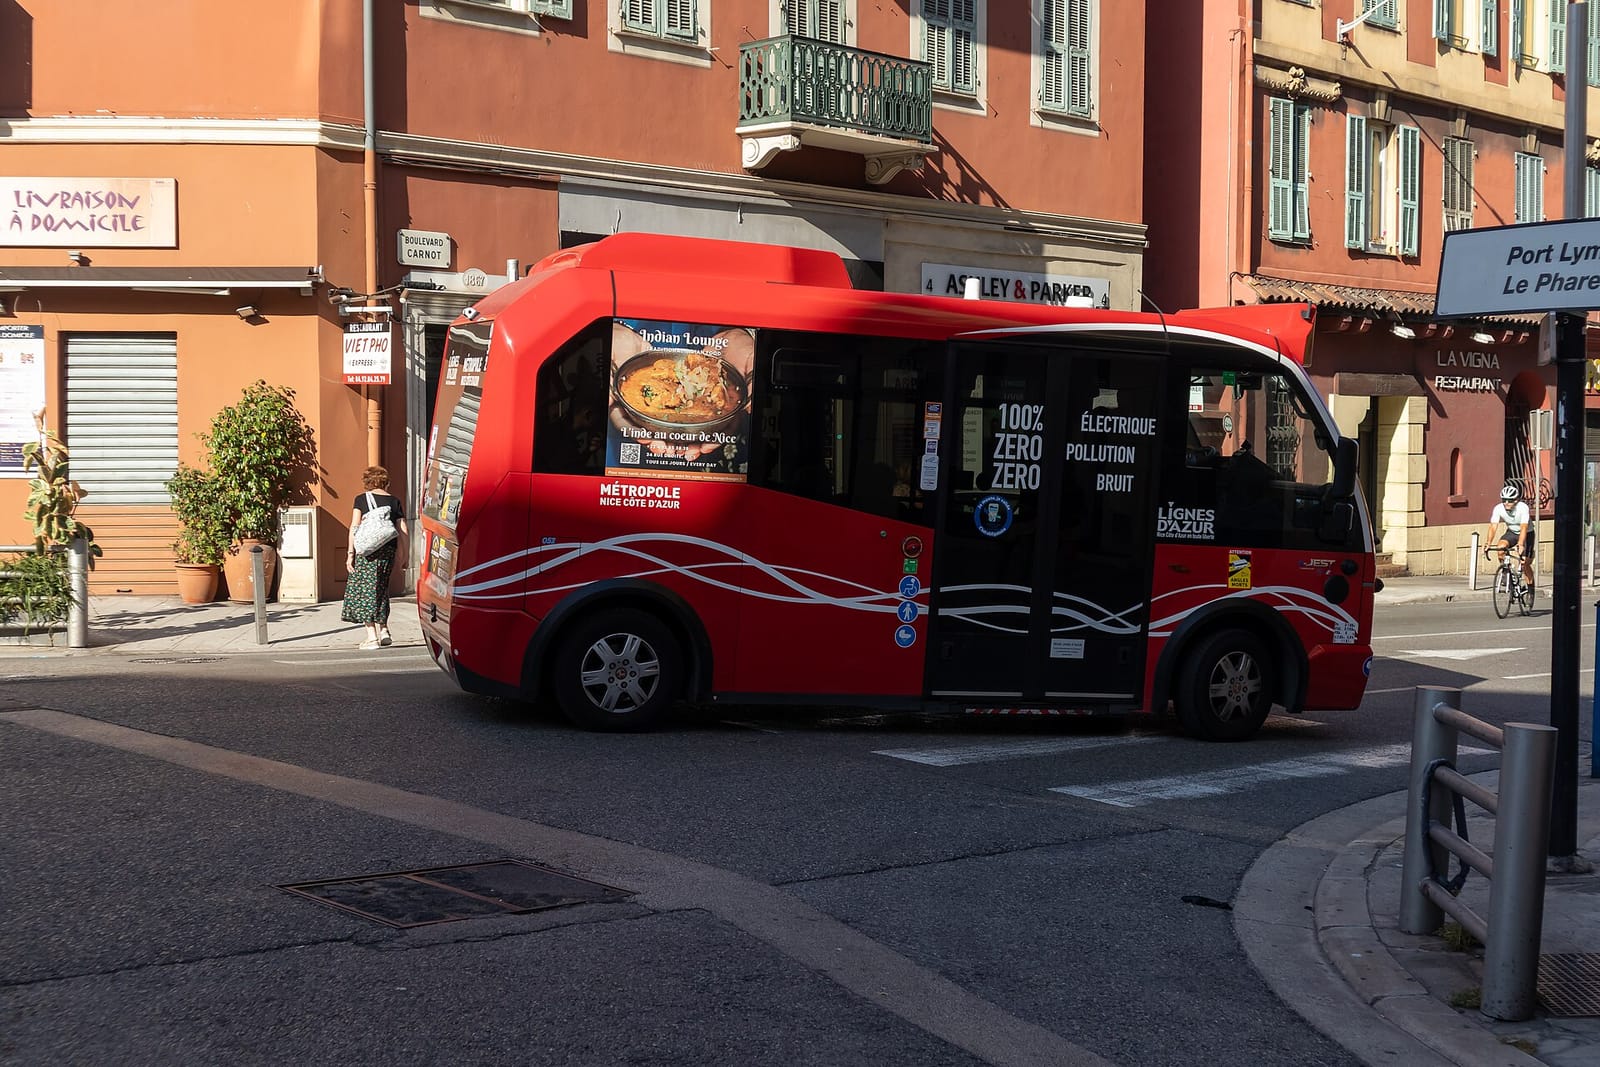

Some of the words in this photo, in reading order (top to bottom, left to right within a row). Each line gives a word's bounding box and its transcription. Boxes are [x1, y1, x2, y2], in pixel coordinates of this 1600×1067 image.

[405, 236, 444, 247] BOULEVARD
[407, 248, 441, 260] CARNOT
[1506, 244, 1554, 265] Port
[464, 275, 485, 287] 1867
[926, 279, 933, 292] 4
[946, 273, 1010, 297] ASLEY
[1014, 280, 1026, 299] &
[1503, 275, 1529, 294] Le
[1534, 272, 1600, 293] Phare
[350, 323, 383, 332] RESTAURANT
[345, 338, 368, 353] VIET
[369, 337, 388, 353] PHO
[640, 330, 680, 345] Indian
[683, 333, 729, 351] Lounge
[1437, 350, 1457, 367] LA
[1460, 351, 1500, 370] VIGNA
[1435, 375, 1502, 391] RESTAURANT
[999, 403, 1044, 431] 100%
[1081, 410, 1156, 436] ÉLECTRIQUE
[620, 427, 652, 438] L'inde
[654, 432, 667, 440] au
[669, 432, 698, 441] coeur
[699, 432, 711, 442] de
[712, 432, 737, 443] Nice
[993, 433, 1043, 461] ZERO
[1066, 443, 1135, 464] POLLUTION
[991, 462, 1041, 490] ZERO
[1096, 473, 1135, 492] BRUIT
[600, 481, 680, 499] MÉTROPOLE
[600, 497, 621, 506] NICE
[623, 496, 647, 507] CÔTE
[648, 499, 680, 509] D'AZUR
[1158, 502, 1215, 521] LIGNES
[1157, 520, 1215, 534] D'AZUR
